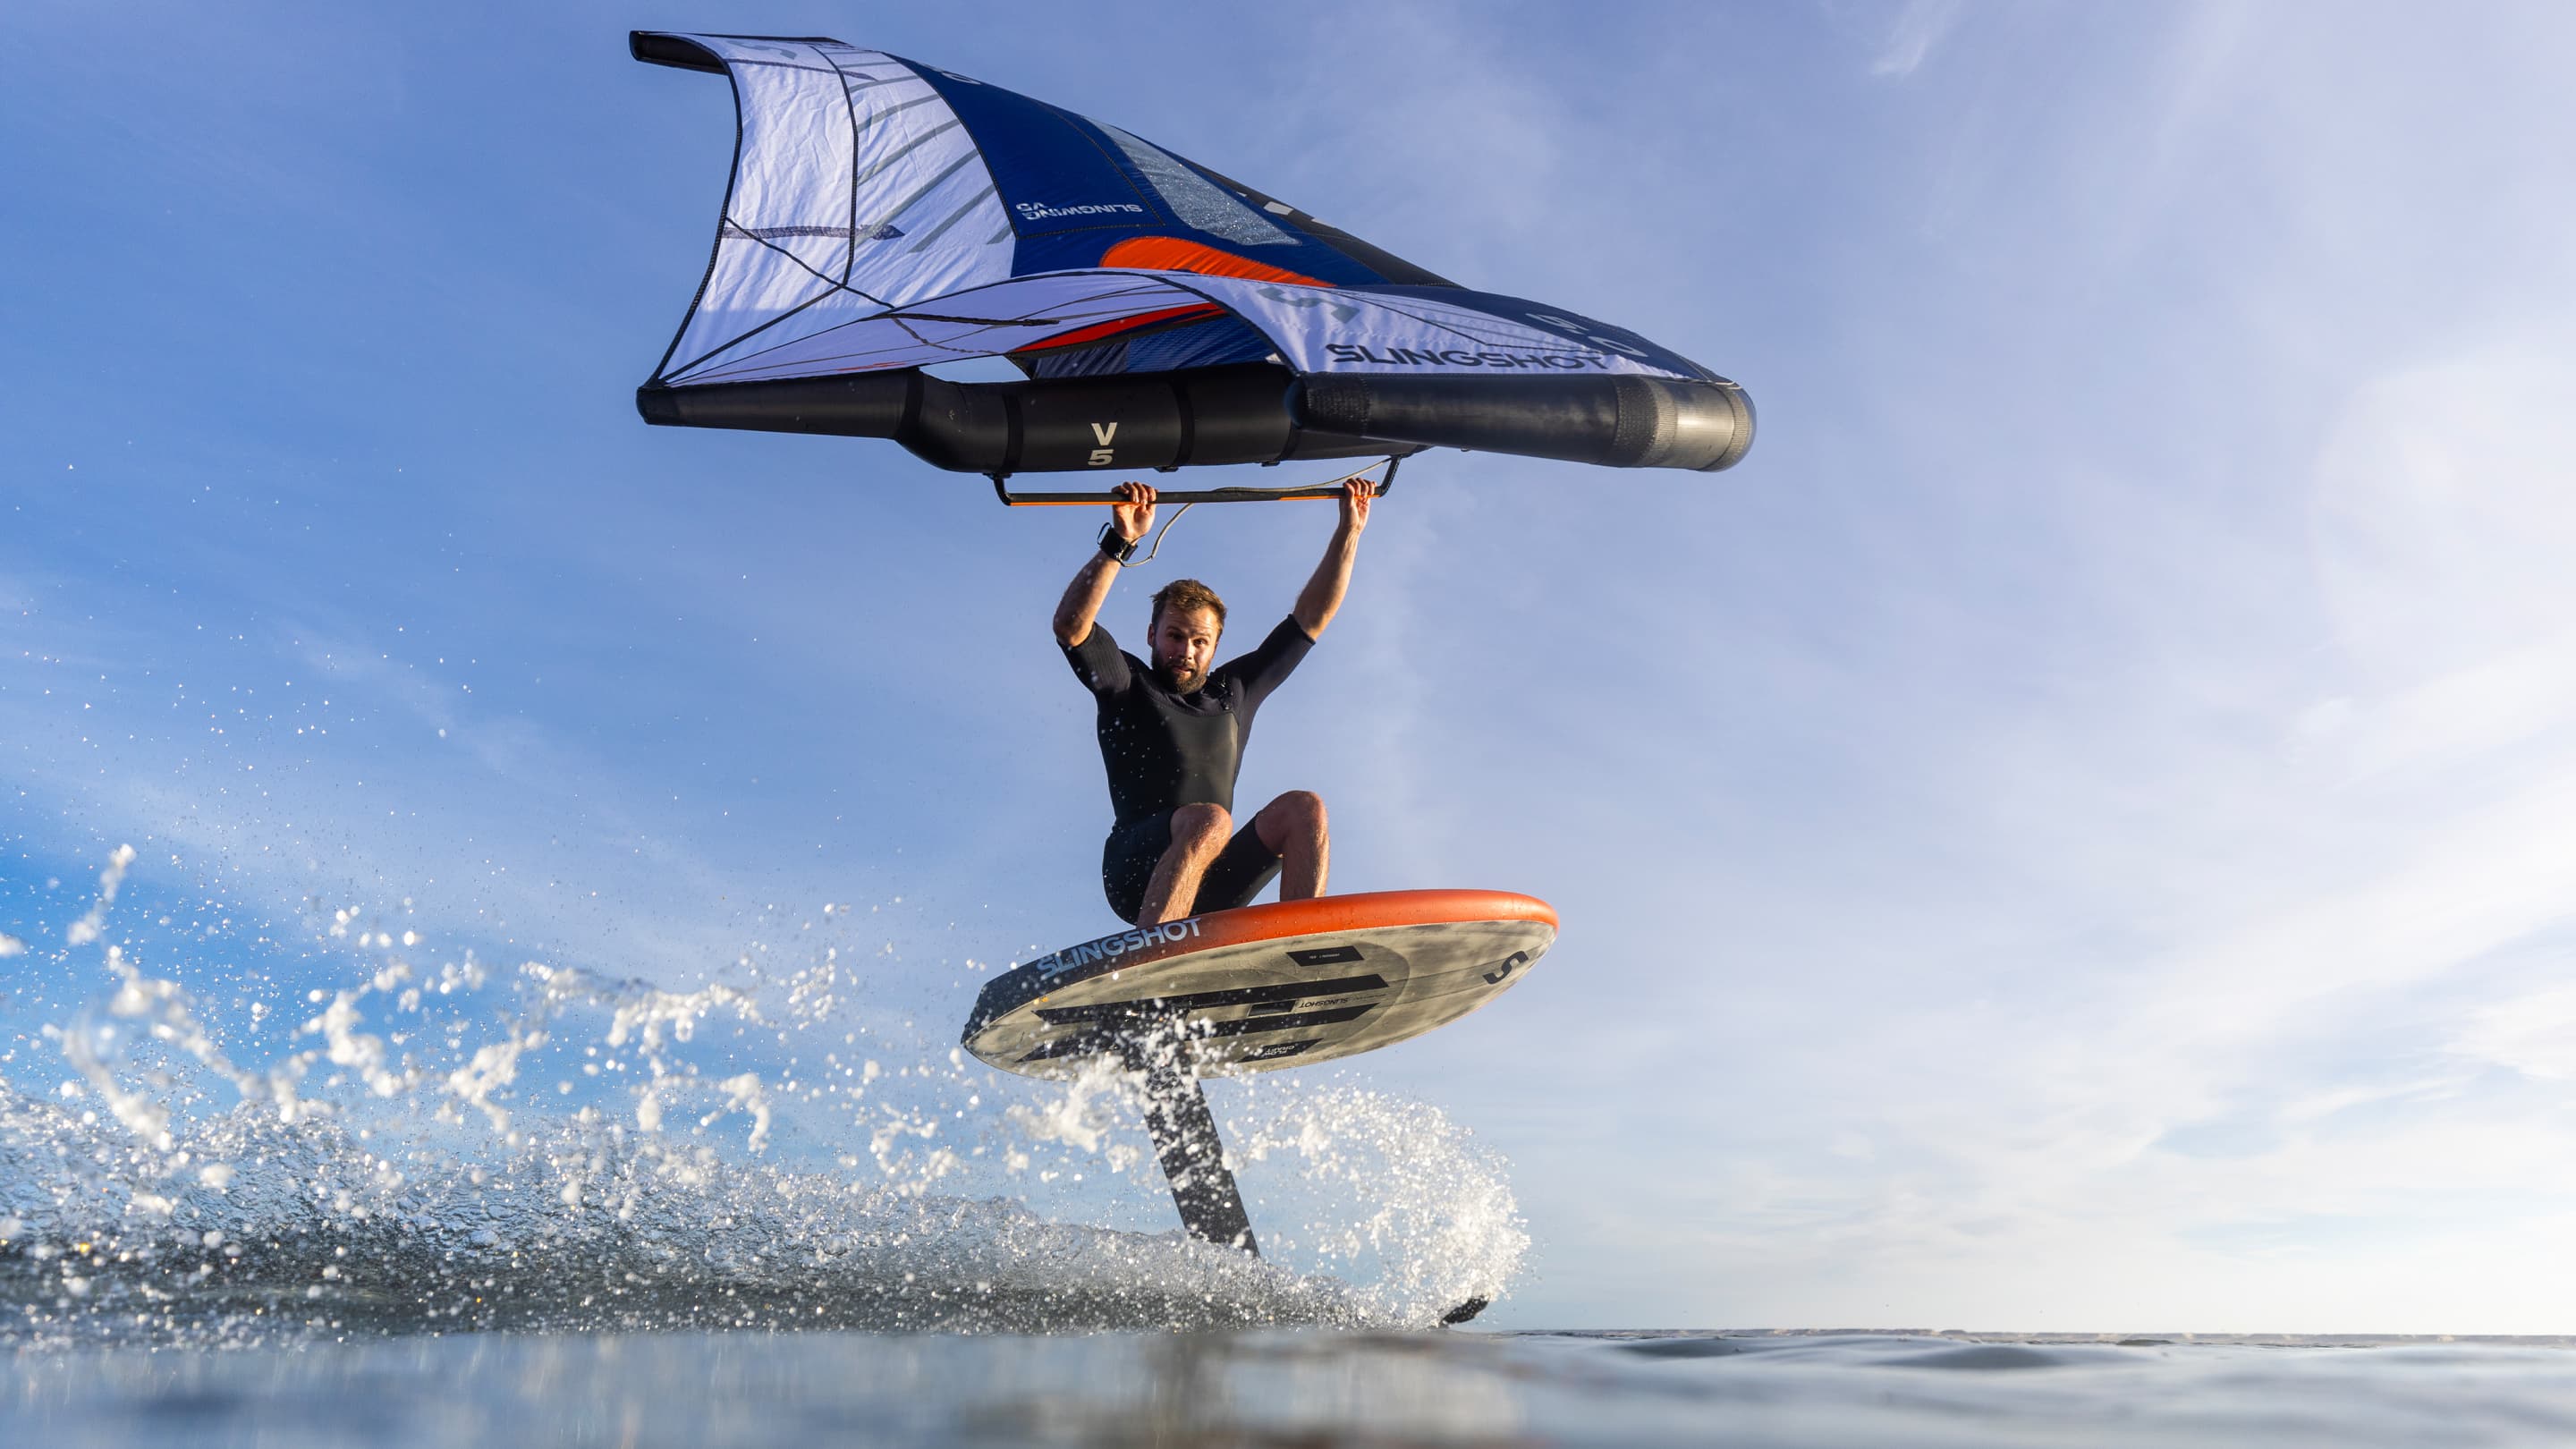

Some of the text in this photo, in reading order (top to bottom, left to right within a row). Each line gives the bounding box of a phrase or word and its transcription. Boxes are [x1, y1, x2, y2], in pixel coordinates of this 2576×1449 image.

[1021, 204, 1143, 220] SLINGWING
[1326, 343, 1607, 369] SLINGSHOT
[1037, 918, 1201, 980] SLINGSHOT
[1299, 998, 1348, 1008] SLINGSHOT
